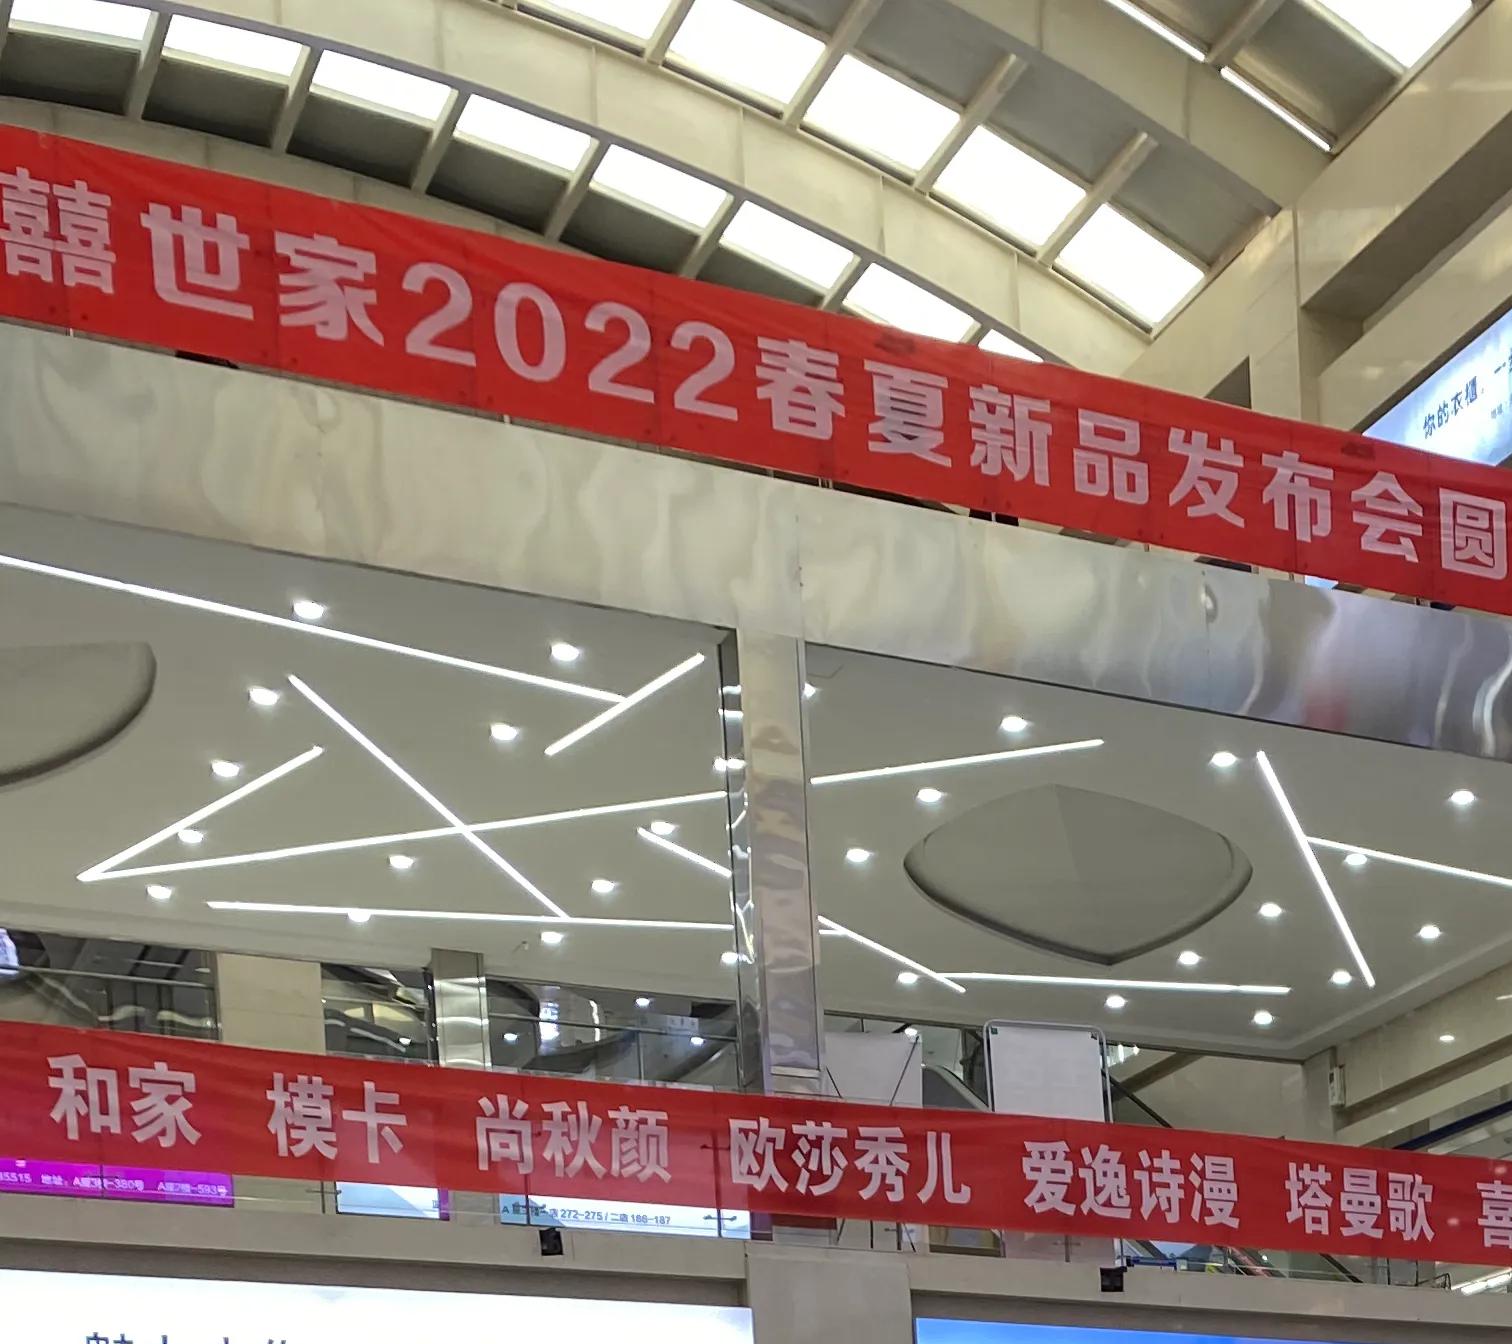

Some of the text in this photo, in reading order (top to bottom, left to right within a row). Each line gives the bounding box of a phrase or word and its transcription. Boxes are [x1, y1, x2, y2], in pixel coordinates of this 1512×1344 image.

[48, 1054, 202, 1149] 和家
[266, 1071, 408, 1164] 模卡
[476, 1094, 670, 1183] 尚秋颜
[728, 1116, 971, 1205] 欧莎秀儿
[1022, 1139, 1240, 1230] 爱逸诗漫
[1285, 1163, 1435, 1242] 塔曼歌
